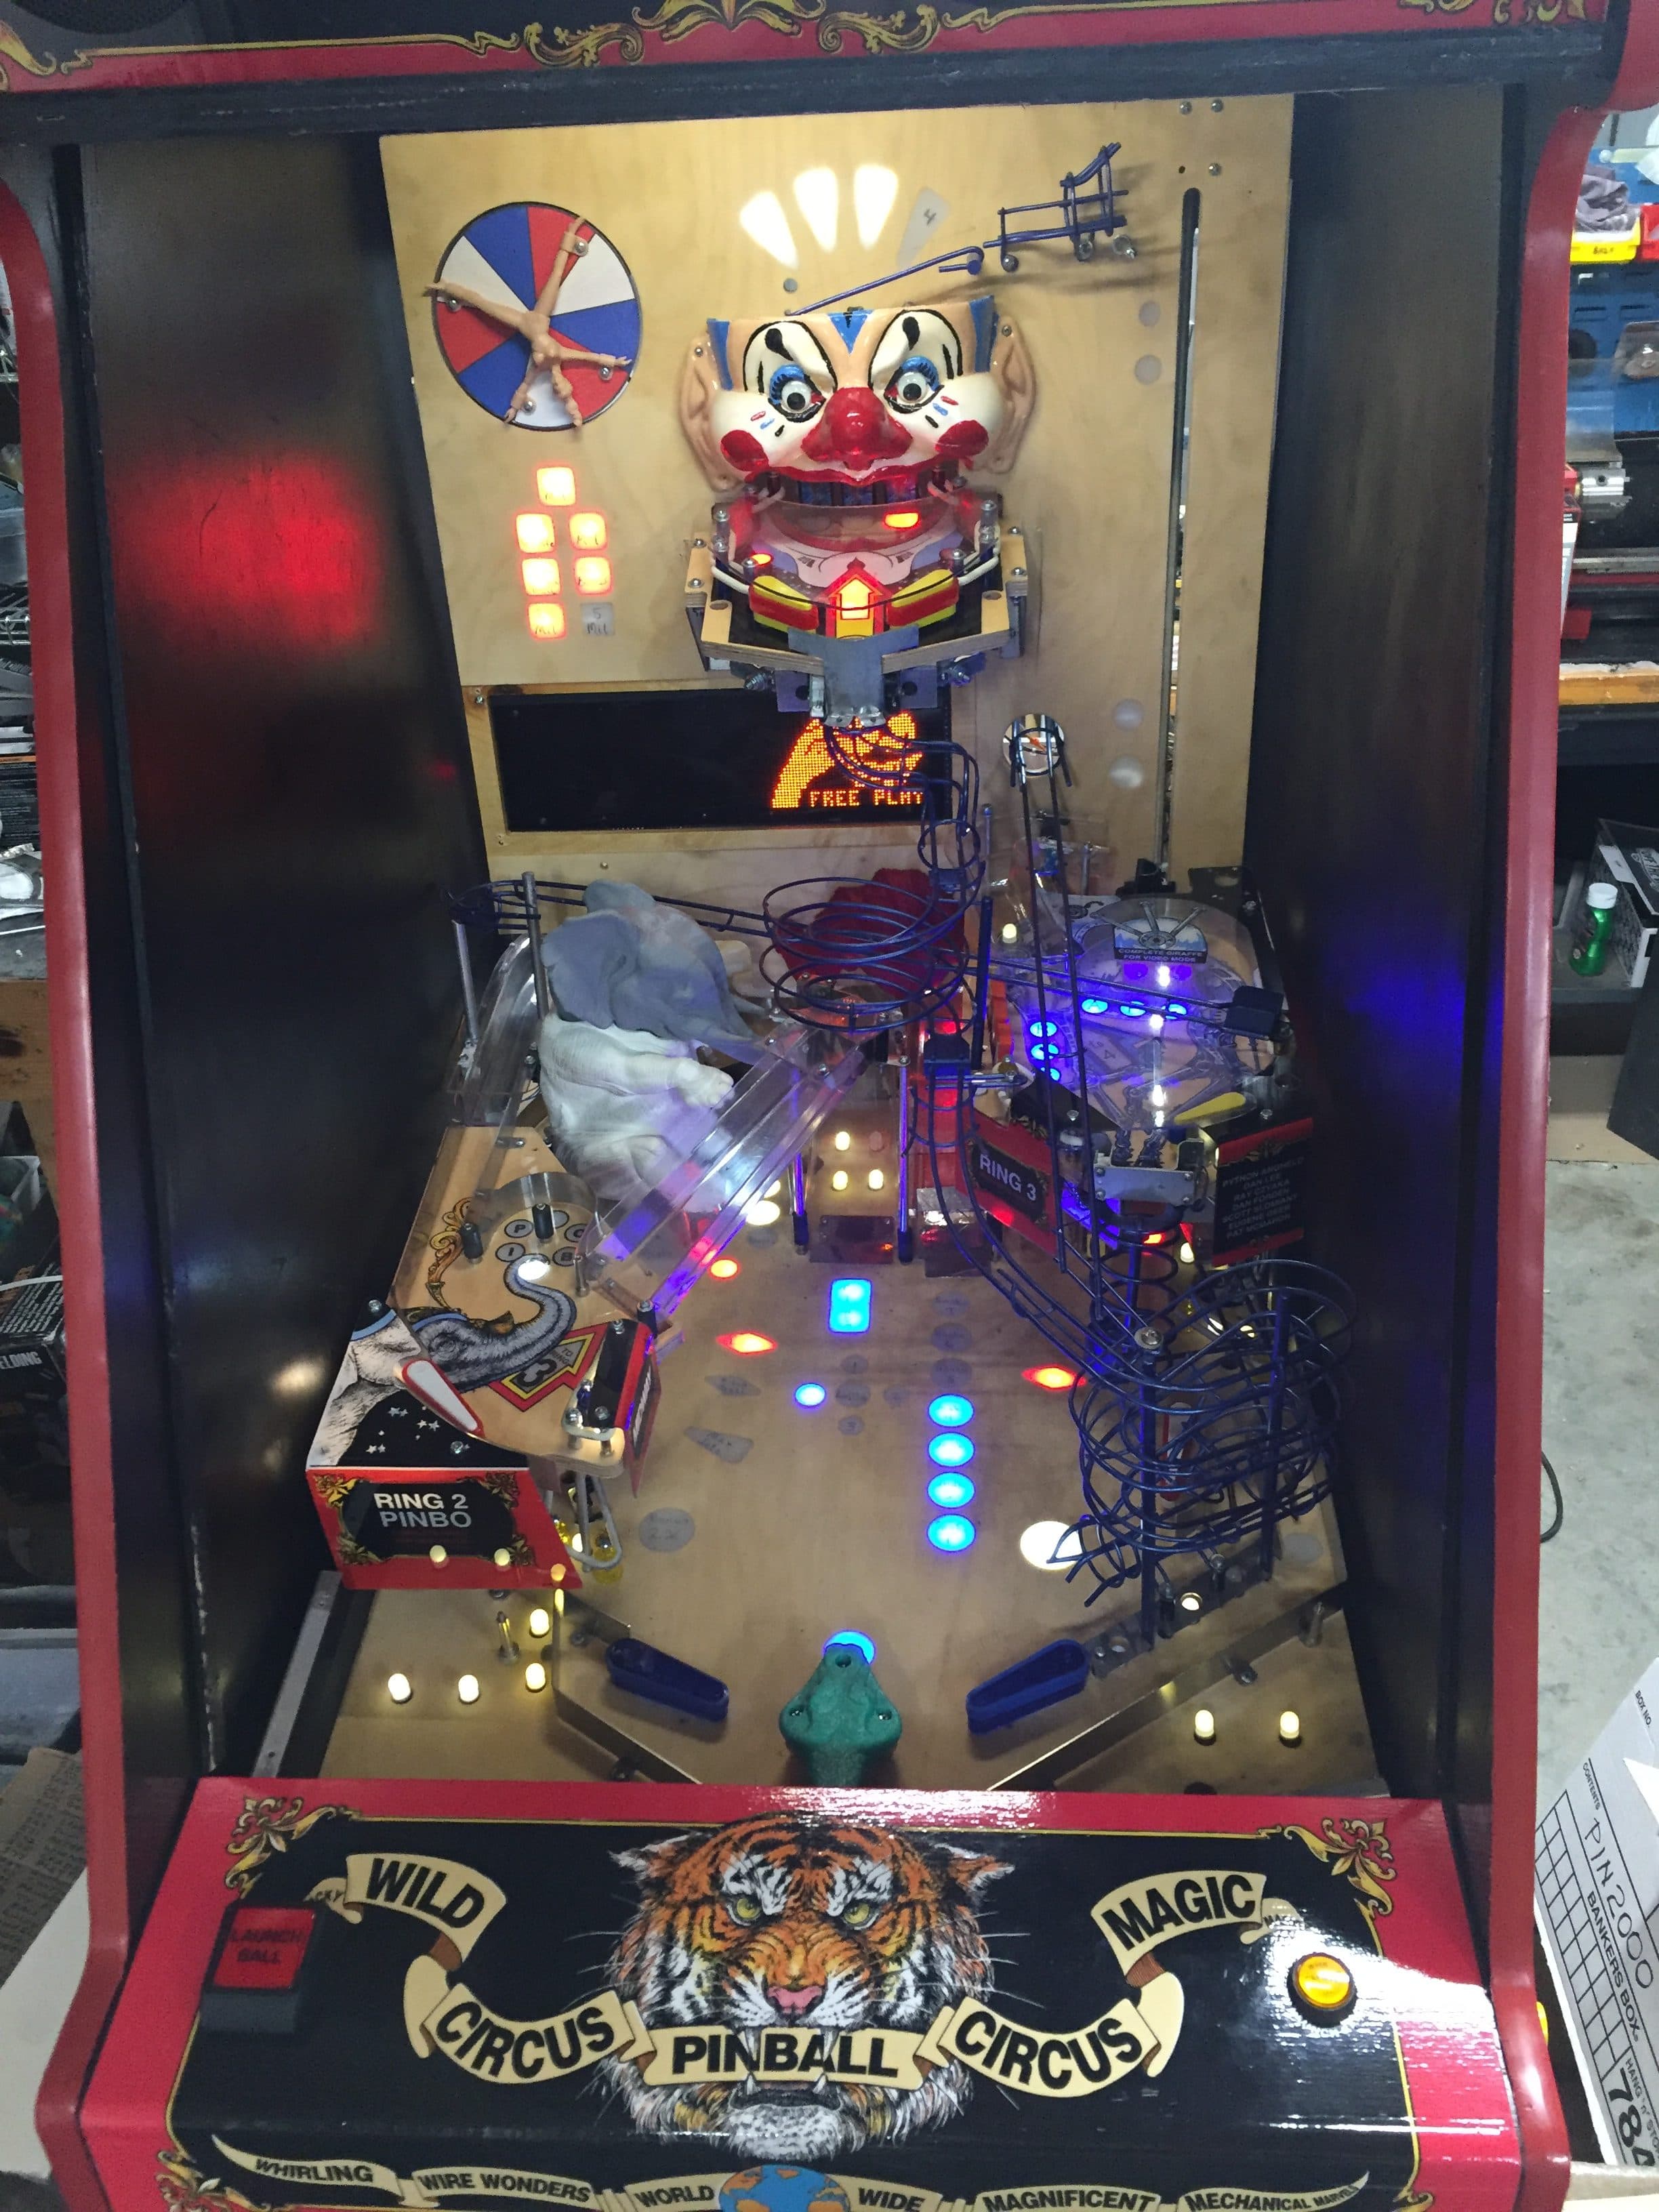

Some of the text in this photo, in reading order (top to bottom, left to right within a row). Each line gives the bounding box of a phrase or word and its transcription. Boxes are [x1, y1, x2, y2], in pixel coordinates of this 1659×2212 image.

[810, 789, 860, 808] FREE
[979, 1153, 1036, 1201] RING 3
[514, 1224, 527, 1233] P
[516, 1358, 558, 1388] 3
[373, 1492, 469, 1510] RING 2
[379, 1511, 472, 1528] PINBO
[1635, 1689, 1647, 1711] BOX
[1582, 1762, 1601, 1811] CONTENTS
[366, 1857, 485, 1929] WILD
[1100, 1874, 1256, 1952] MAGIC
[1586, 1890, 1624, 1988] BANKERS
[435, 2001, 615, 2080] CIRCUS
[672, 2033, 899, 2078] PINBALL
[954, 2010, 1143, 2090] CIRCUS
[1625, 2057, 1643, 2099] HANG
[255, 2158, 374, 2183] WHIRLING
[417, 2172, 592, 2203] WIRE WONDERS
[634, 2185, 716, 2208] WORLD
[857, 2187, 926, 2212] WIDE
[983, 2189, 1157, 2212] MAGNIFICENT
[1183, 2192, 1312, 2212] MECHANICAL
